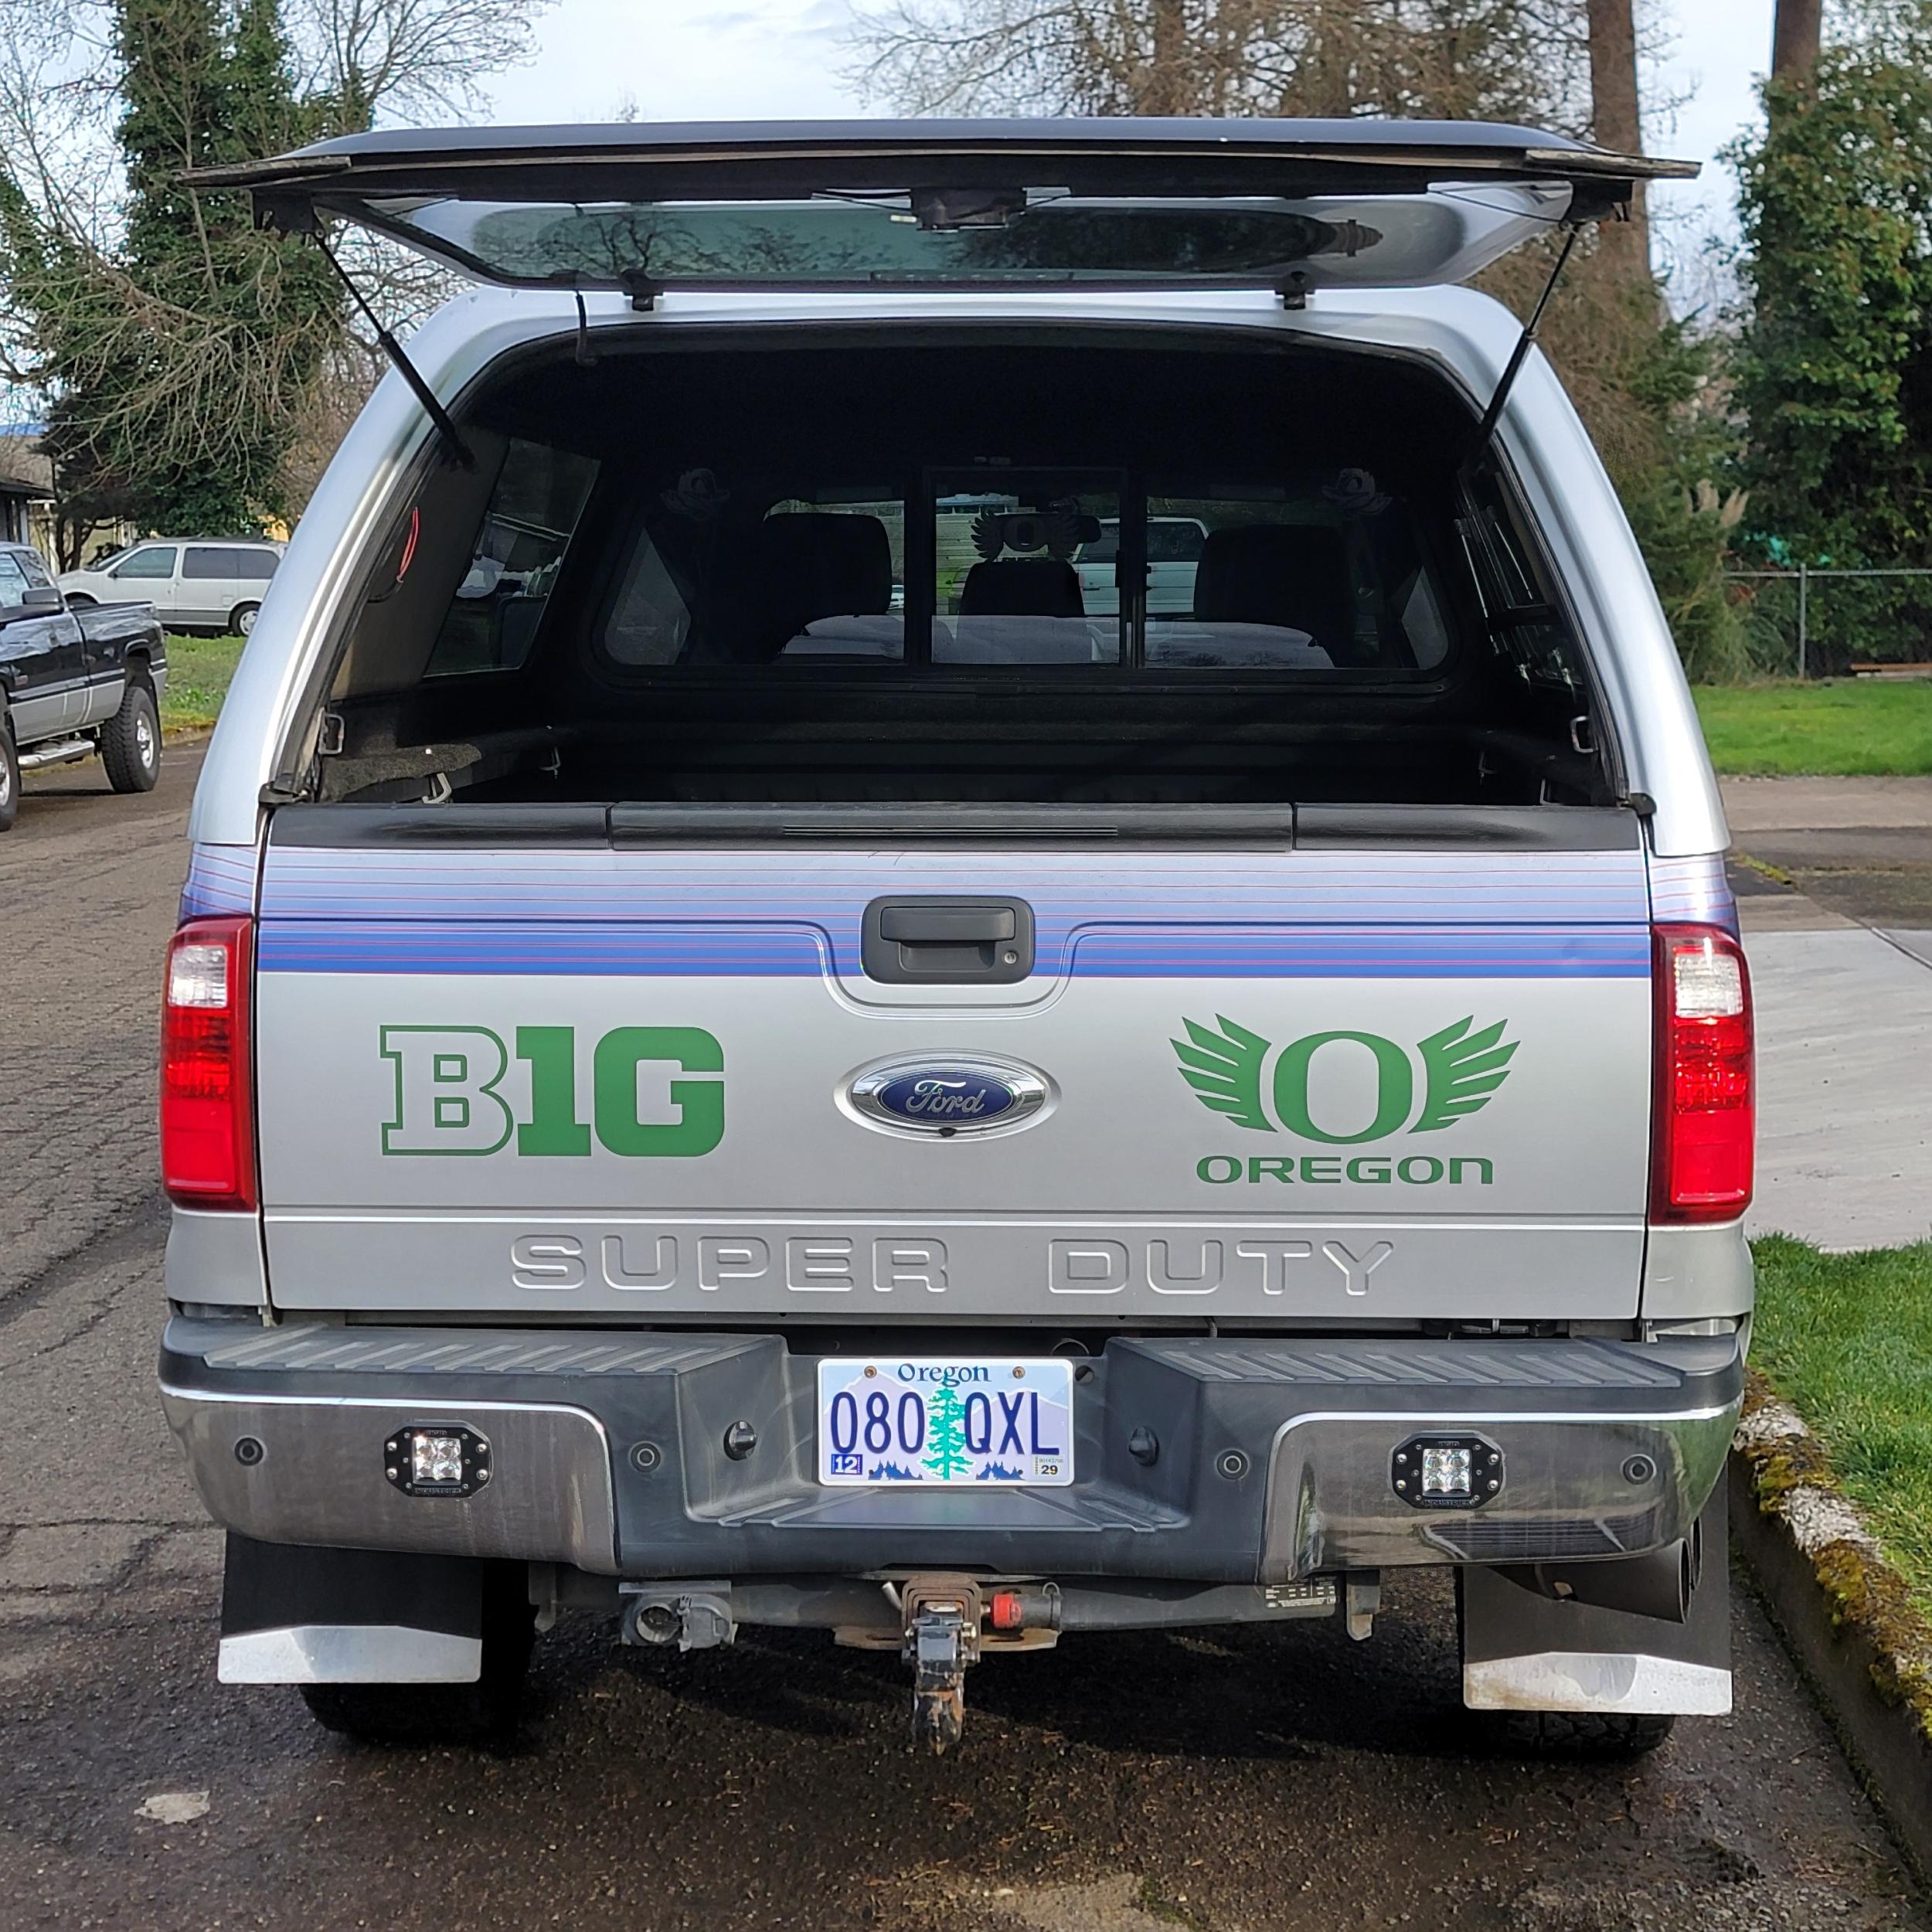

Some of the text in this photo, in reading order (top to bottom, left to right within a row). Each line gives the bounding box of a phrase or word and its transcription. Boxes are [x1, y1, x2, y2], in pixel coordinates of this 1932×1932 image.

[905, 1080, 987, 1114] Ford
[1196, 1155, 1493, 1185] OREGON
[510, 1234, 1395, 1296] SUPER DUTY
[897, 1362, 992, 1388] Oregon
[830, 1391, 1060, 1456] 080 QXL
[835, 1455, 858, 1474] 12
[1041, 1464, 1059, 1475] 29
